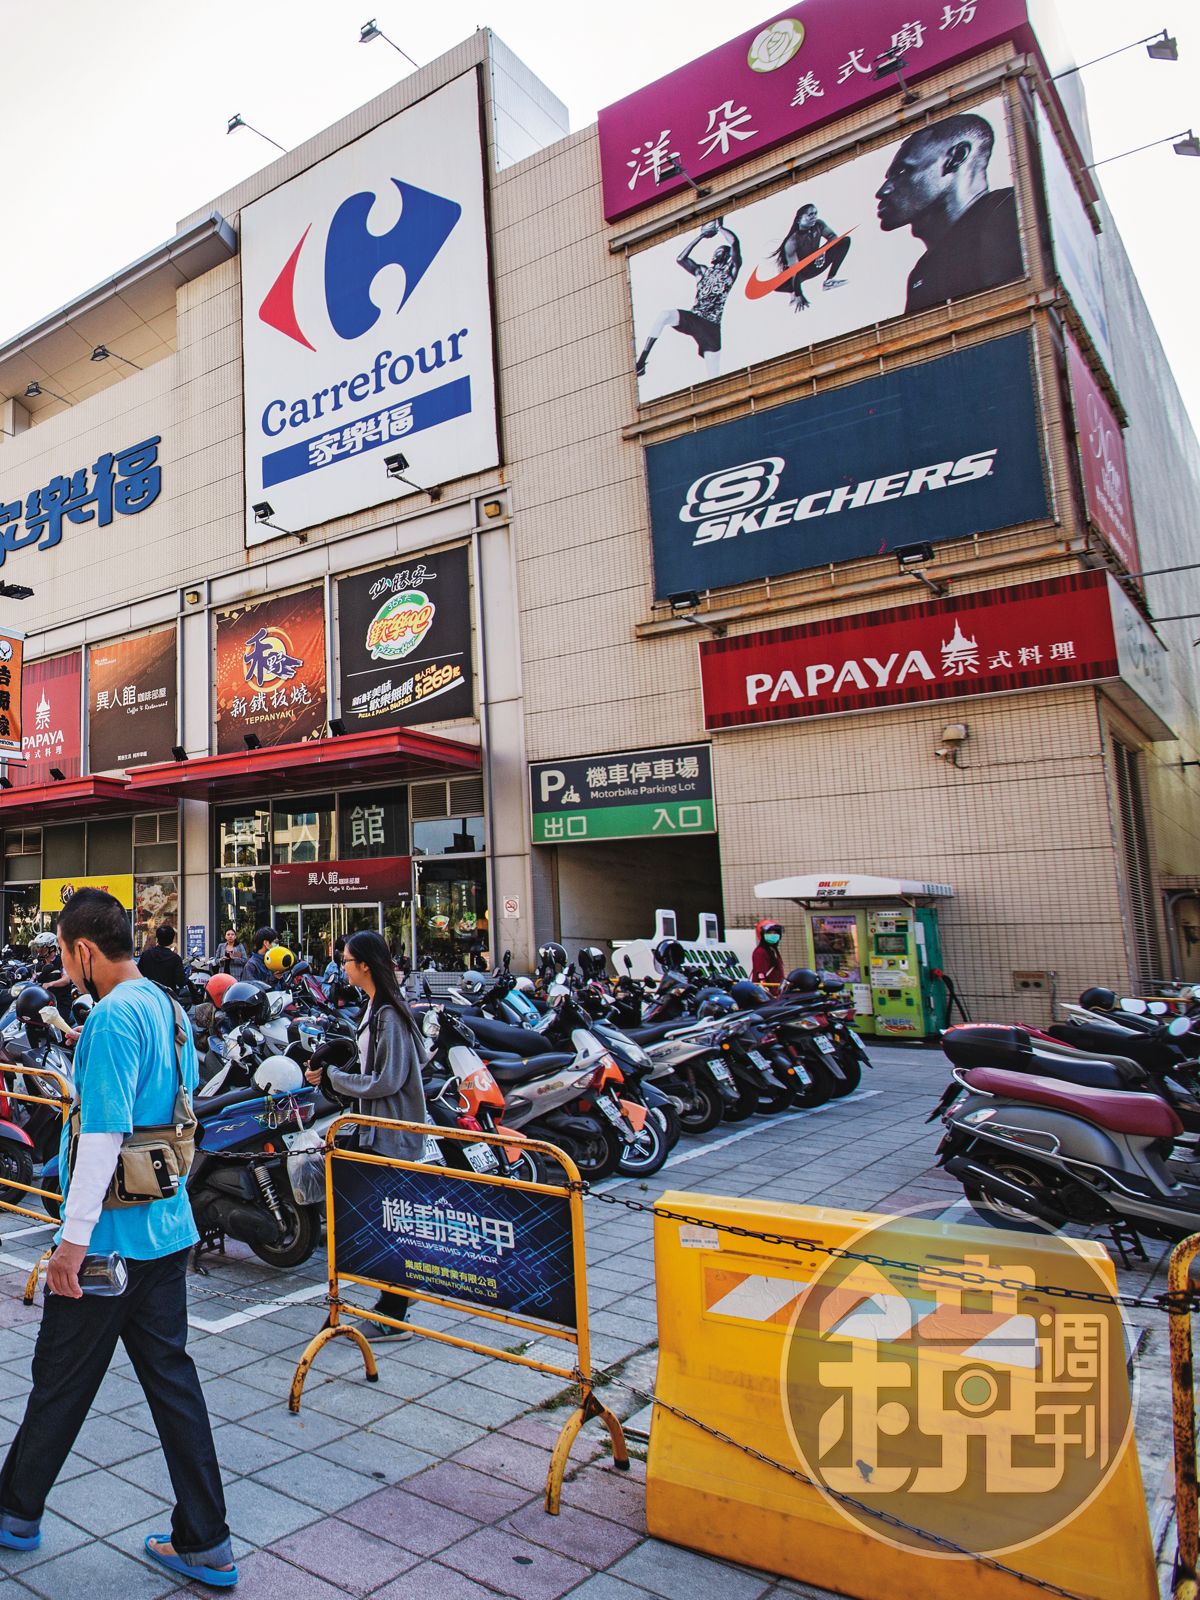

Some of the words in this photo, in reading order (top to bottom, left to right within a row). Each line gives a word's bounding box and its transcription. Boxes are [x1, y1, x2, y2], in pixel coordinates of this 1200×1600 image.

[627, 99, 759, 191] 洋朵
[261, 328, 468, 437] Carrefour
[308, 402, 414, 466] 家樂福
[692, 448, 998, 547] SKECHERS
[745, 650, 935, 706] PAPAYA
[96, 684, 137, 711] 異人館
[230, 682, 312, 718] 新鐵板燒
[245, 709, 295, 725] TEPPANYAKI
[22, 730, 64, 750] PAPAYA
[539, 770, 566, 803] P
[586, 756, 699, 788] 機車停車場
[590, 787, 639, 799] Motorbike
[640, 783, 678, 795] Parking
[678, 782, 696, 791] Lot
[544, 815, 587, 838] 出口
[652, 806, 702, 831] 入口
[308, 872, 339, 886] 異人館
[382, 1196, 515, 1257] 機動戰甲
[404, 1259, 498, 1289] 樂威國際實業有限公司
[463, 1252, 499, 1265] ARMOR
[426, 1275, 473, 1293] INTERNATIONAL
